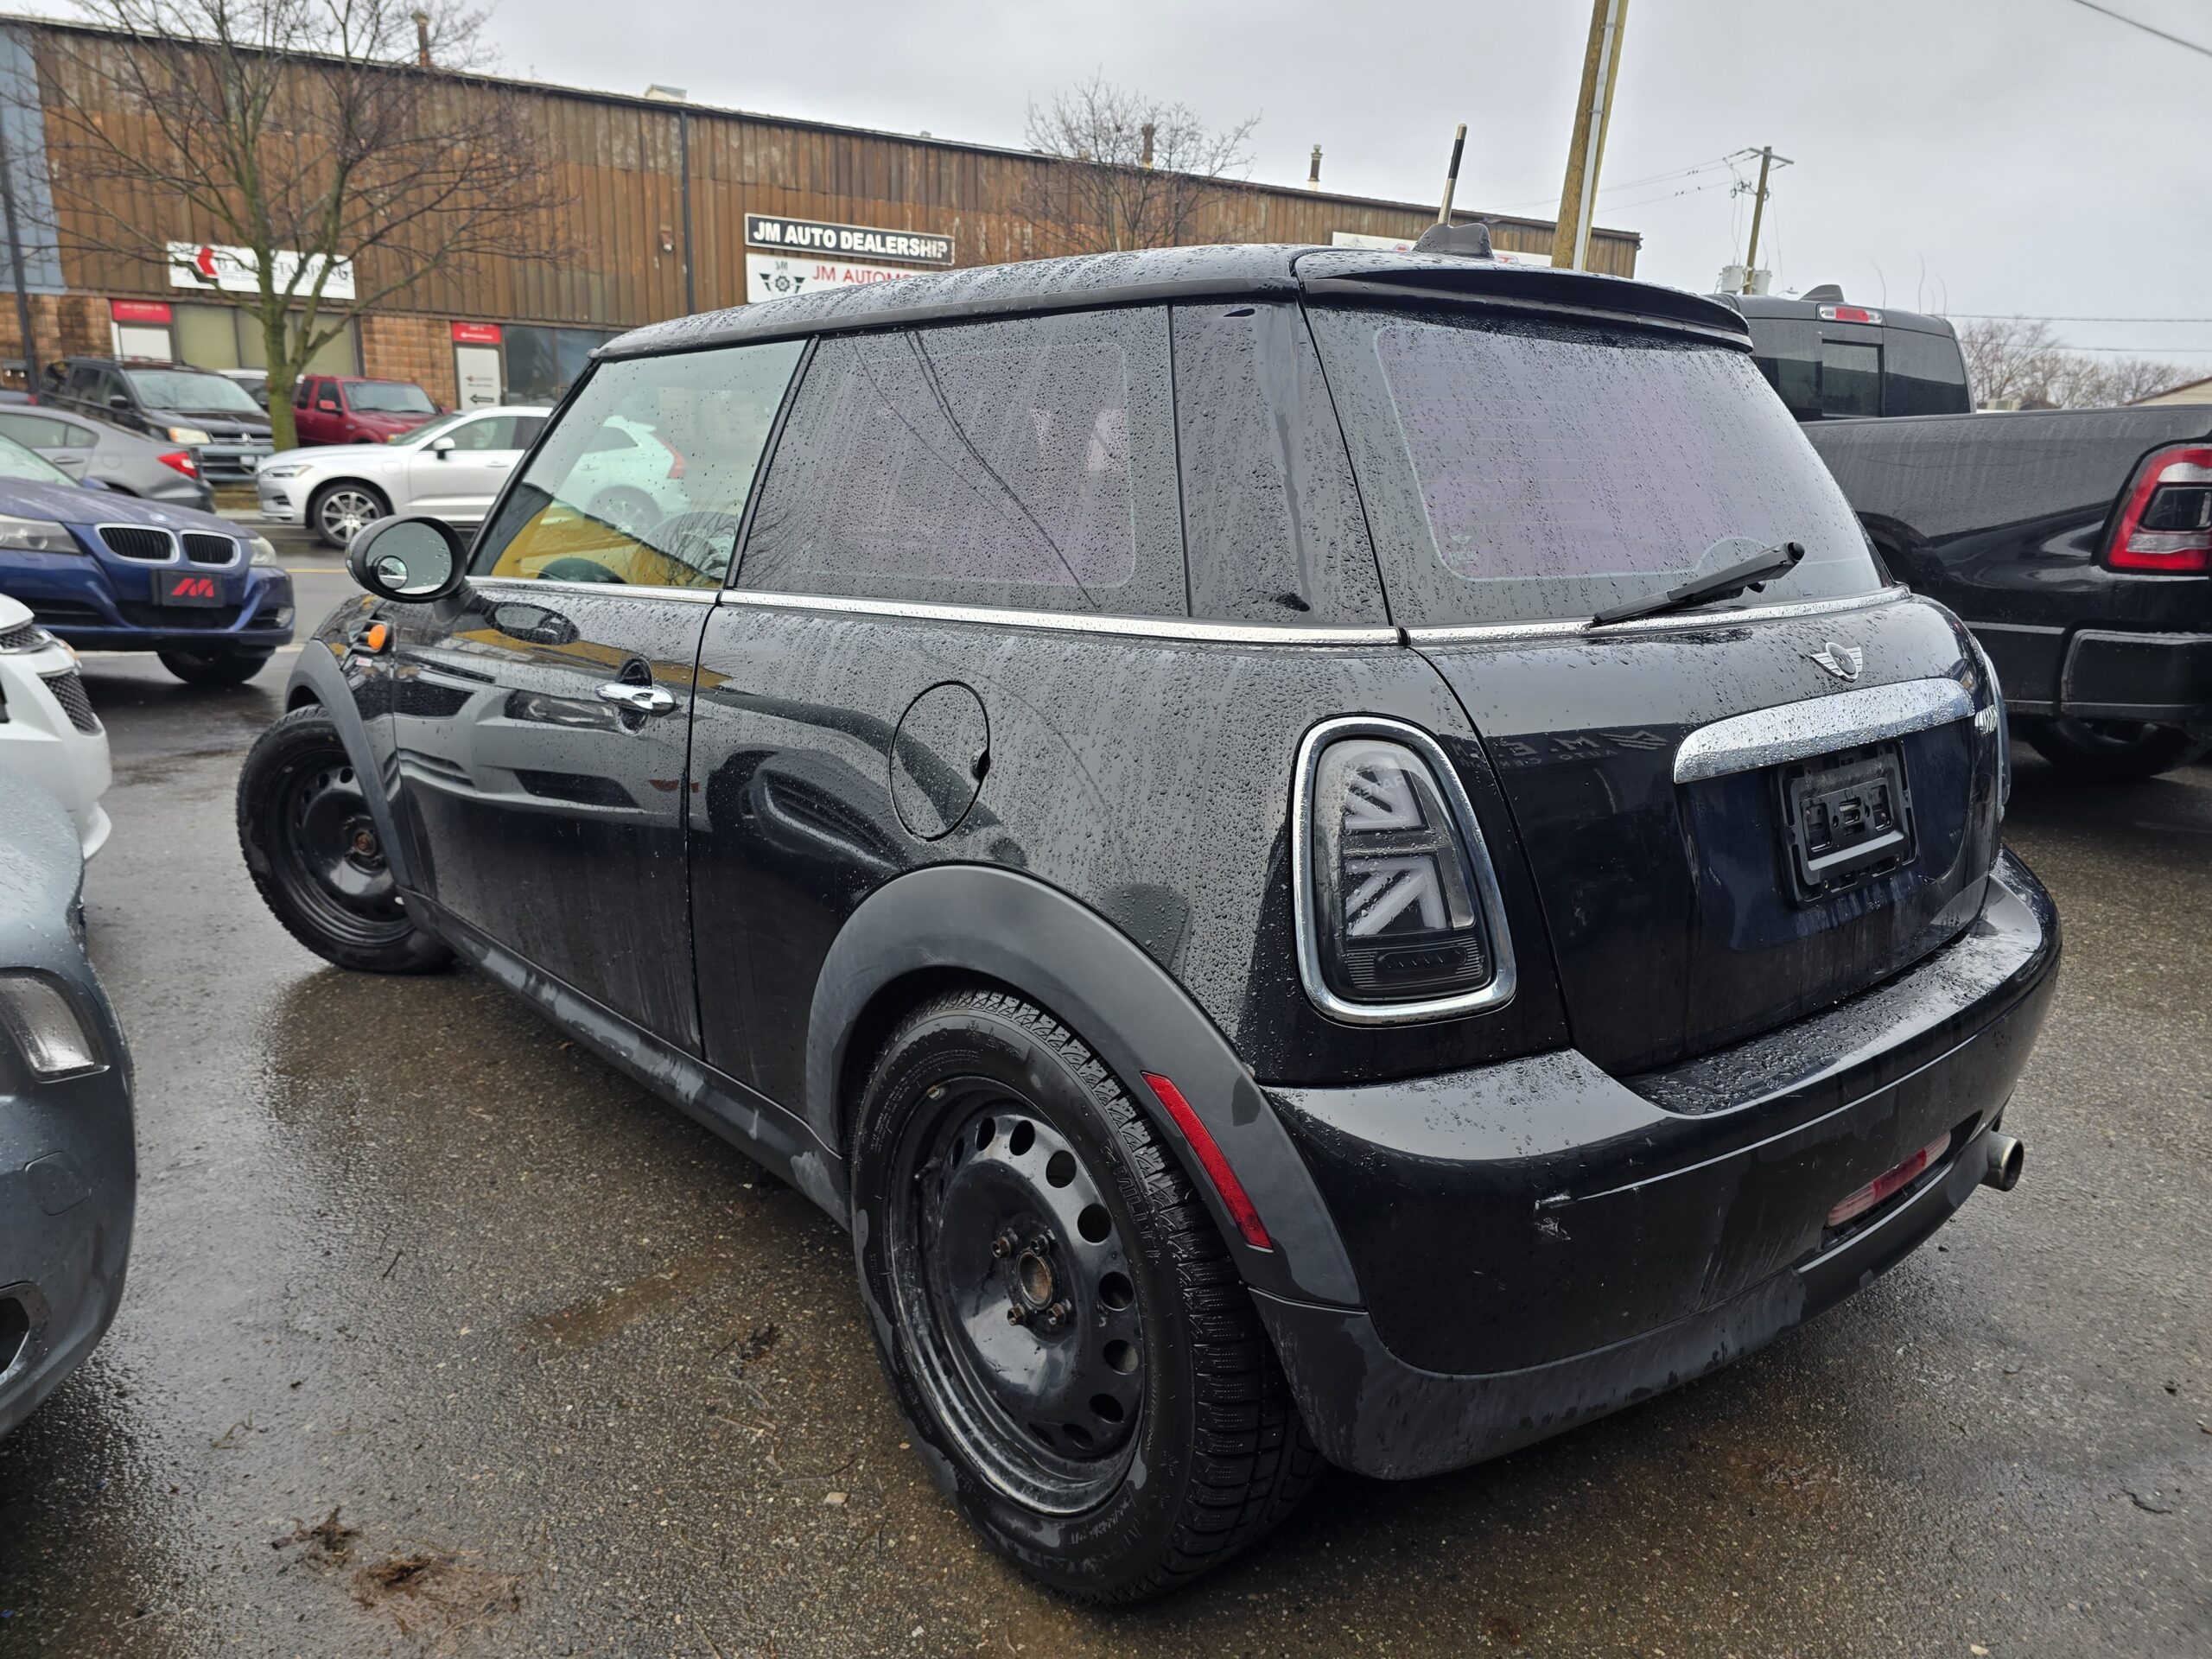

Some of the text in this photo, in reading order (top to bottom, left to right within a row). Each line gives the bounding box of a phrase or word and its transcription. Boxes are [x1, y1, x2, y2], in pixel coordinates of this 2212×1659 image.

[753, 221, 948, 258] JM AUTO DEALERSHIP
[812, 265, 836, 281] JM
